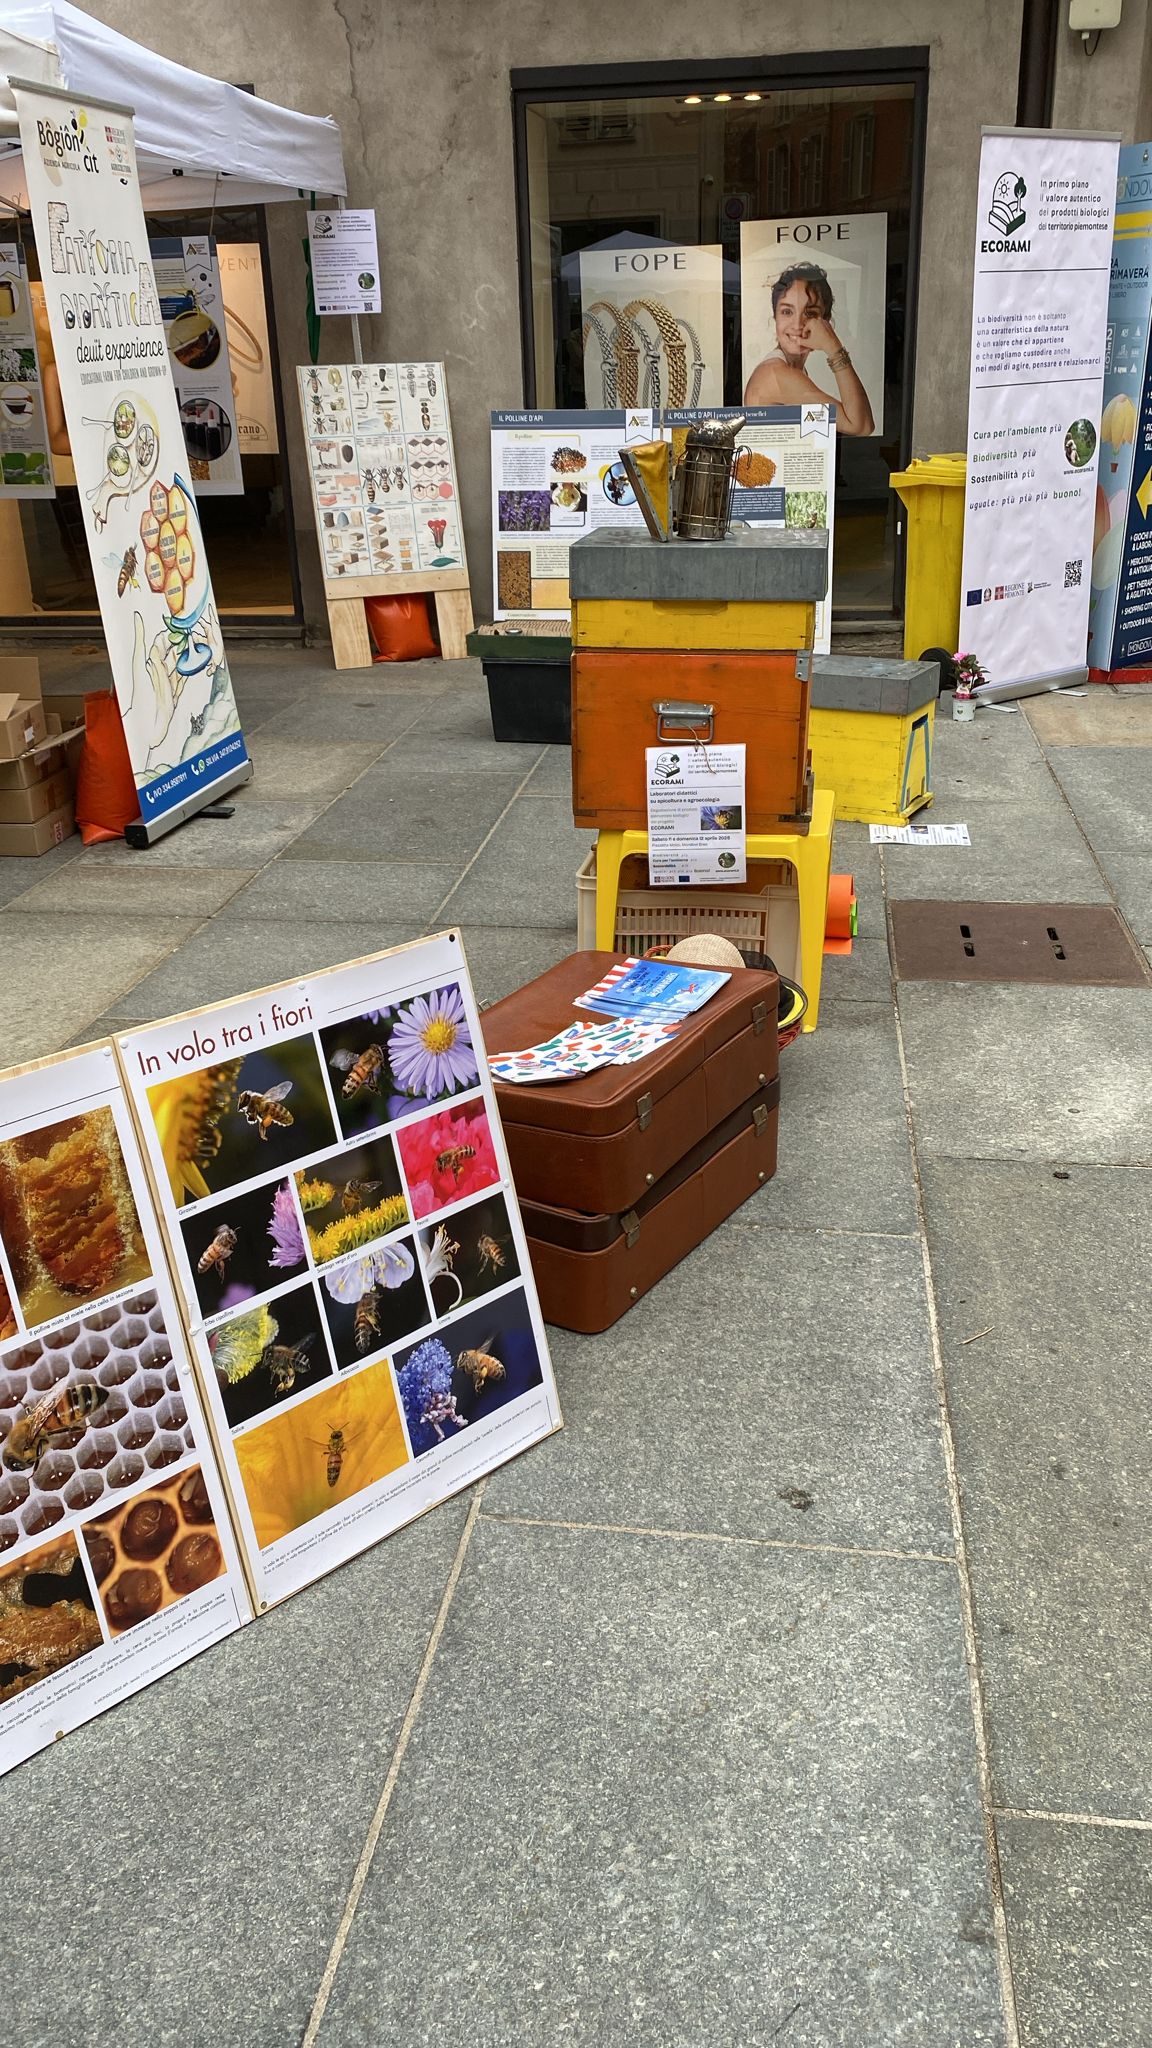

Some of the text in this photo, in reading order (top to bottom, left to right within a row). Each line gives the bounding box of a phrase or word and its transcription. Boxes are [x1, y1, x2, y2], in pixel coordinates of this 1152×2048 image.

[44, 158, 80, 171] AZIENDA AGRICOLA
[1049, 181, 1069, 189] primo
[1072, 181, 1089, 189] piano
[1051, 208, 1078, 217] prodotti
[1080, 208, 1109, 217] biologici
[776, 223, 850, 243] FOPE
[981, 240, 1030, 252] ECORAMI
[614, 253, 686, 272] FOPE
[988, 313, 1022, 323] biodiversità
[1043, 312, 1066, 320] soltanto
[991, 326, 1032, 334] caratteristica
[1032, 337, 1063, 346] appartiene
[106, 337, 164, 369] experience
[995, 351, 1021, 360] vogliamo
[1012, 363, 1030, 372] agire,
[1033, 361, 1056, 372] pensare
[1064, 357, 1100, 366] relazionarci
[505, 414, 527, 422] POLLINE
[529, 414, 543, 422] D'API
[698, 410, 712, 419] D'API
[974, 424, 1061, 440] Cura per l'ambiente più
[973, 449, 1036, 462] Biodiversità più
[971, 469, 1035, 484] Sostenibilità più
[970, 488, 1081, 511] uguale: più più più buono!
[137, 998, 313, 1075] In volo tra i fiori
[34, 1324, 50, 1335] polline
[51, 1318, 64, 1326] misto
[85, 1304, 96, 1312] nella
[98, 1298, 109, 1306] cella
[116, 1288, 133, 1298] sezione
[120, 1632, 131, 1641] larve
[132, 1621, 150, 1634] immerse
[164, 1605, 178, 1616] pappa
